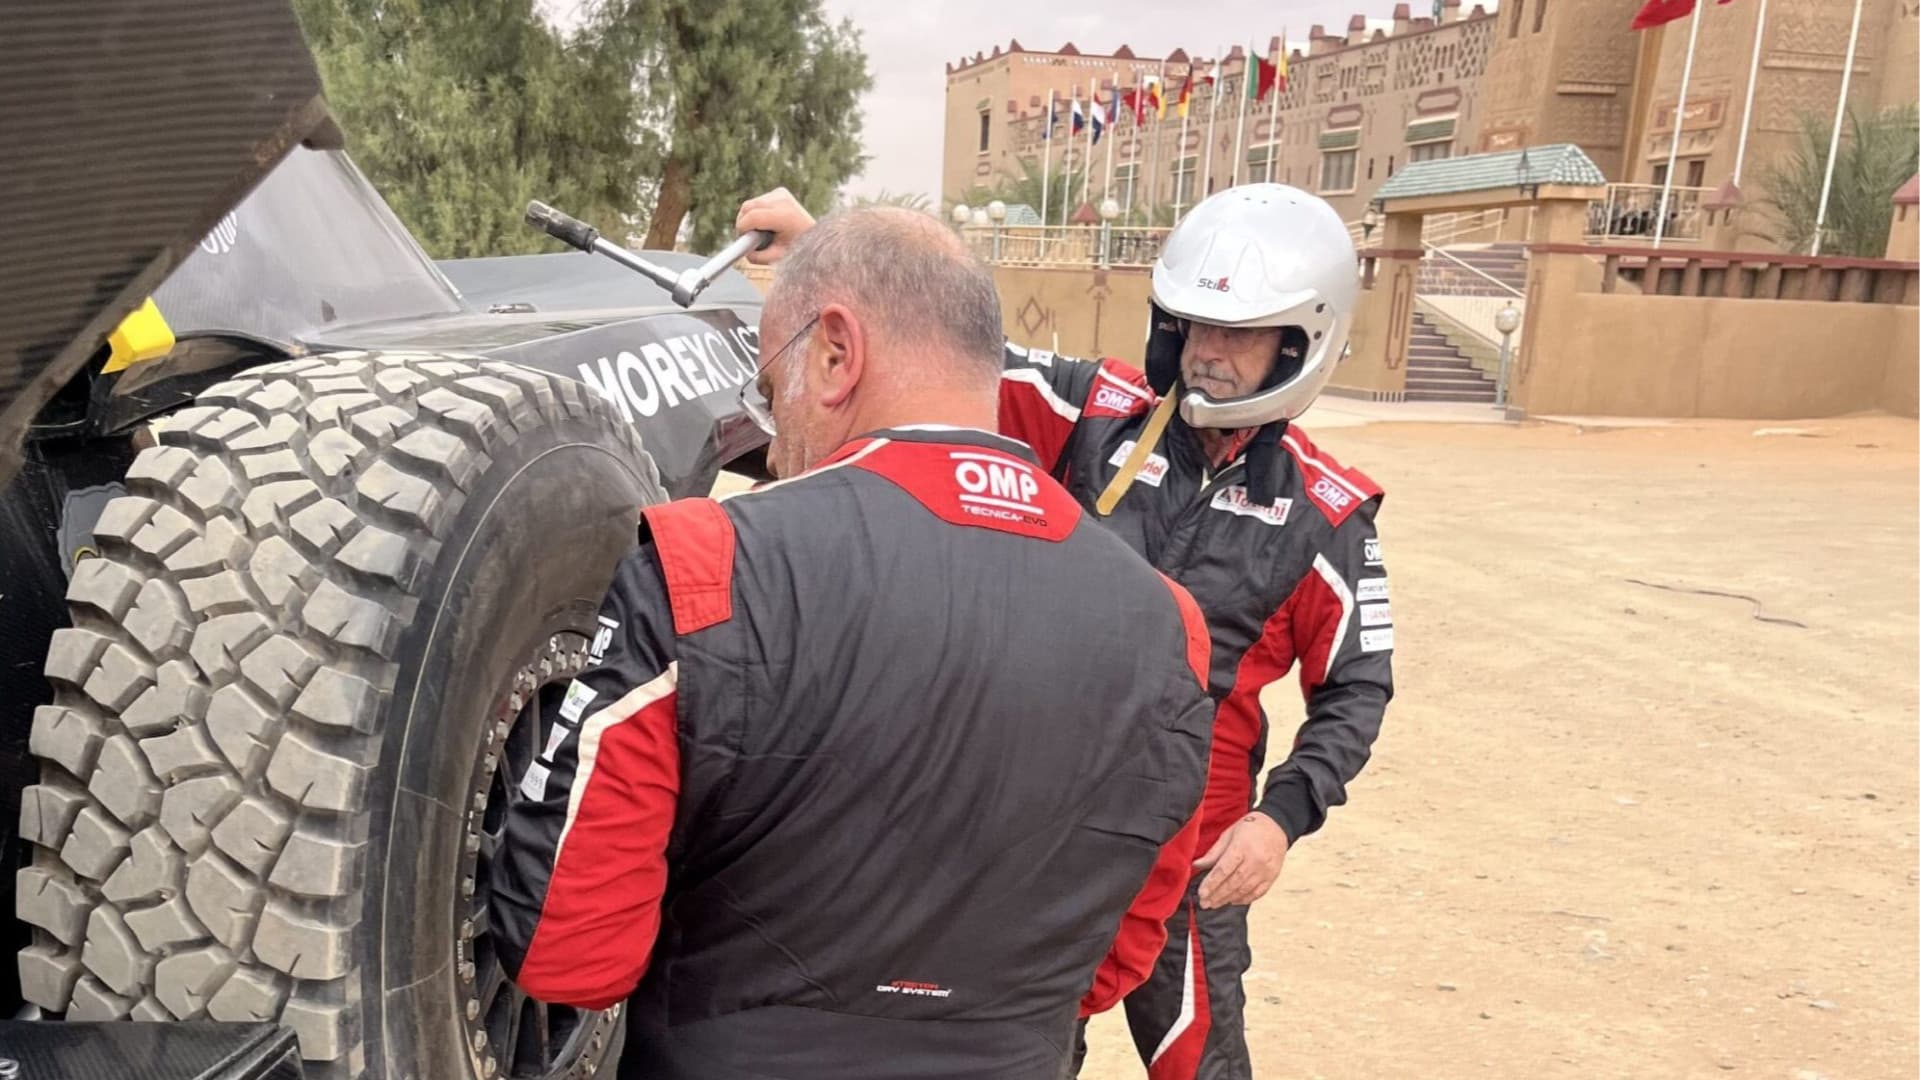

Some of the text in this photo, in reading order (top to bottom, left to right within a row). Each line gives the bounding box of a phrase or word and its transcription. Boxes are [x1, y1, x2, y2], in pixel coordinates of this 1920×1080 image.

[1096, 389, 1133, 411] OMP
[955, 461, 1039, 504] OMP
[1314, 480, 1350, 508] OMP
